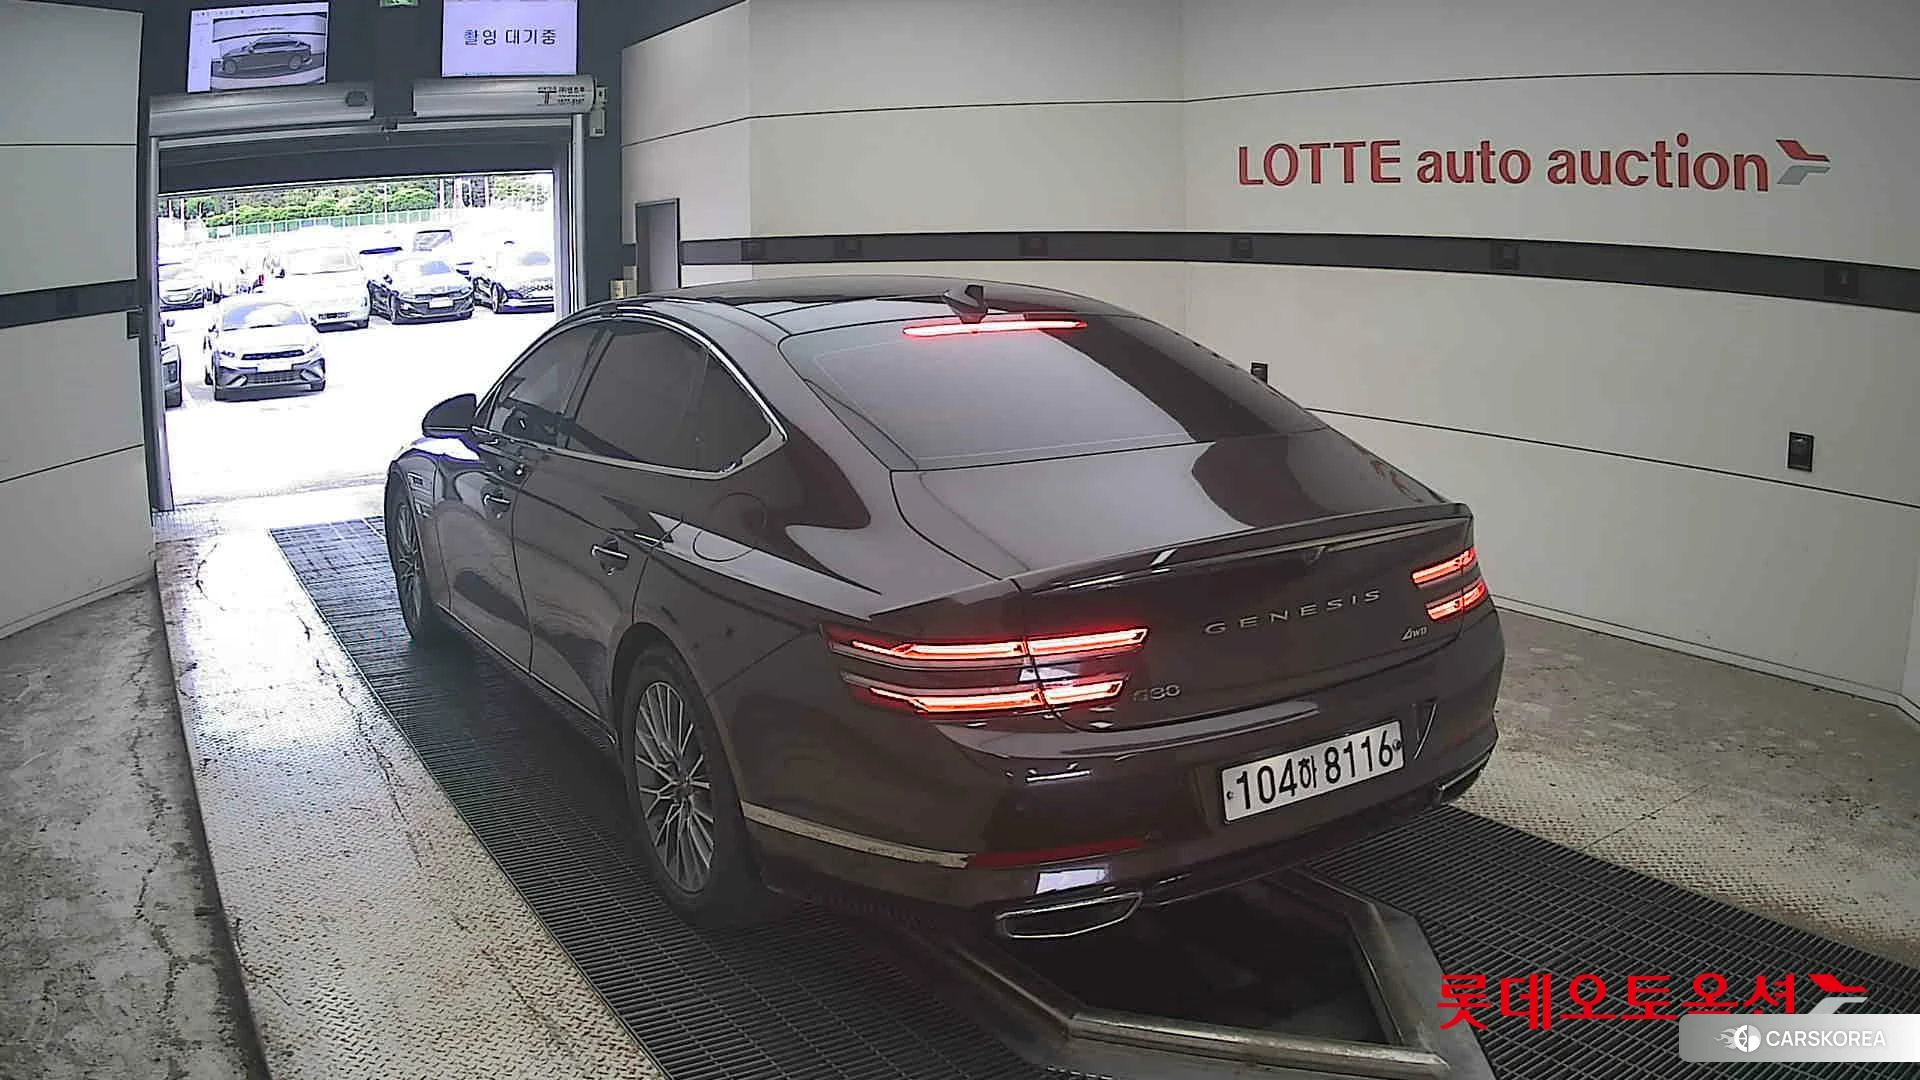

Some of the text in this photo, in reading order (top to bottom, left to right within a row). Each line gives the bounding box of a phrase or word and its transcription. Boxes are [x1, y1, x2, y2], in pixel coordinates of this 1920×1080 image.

[464, 29, 556, 46] 촬영 대기중
[1238, 132, 1769, 192] LOTTE auto auction
[1203, 588, 1382, 635] GENESIS
